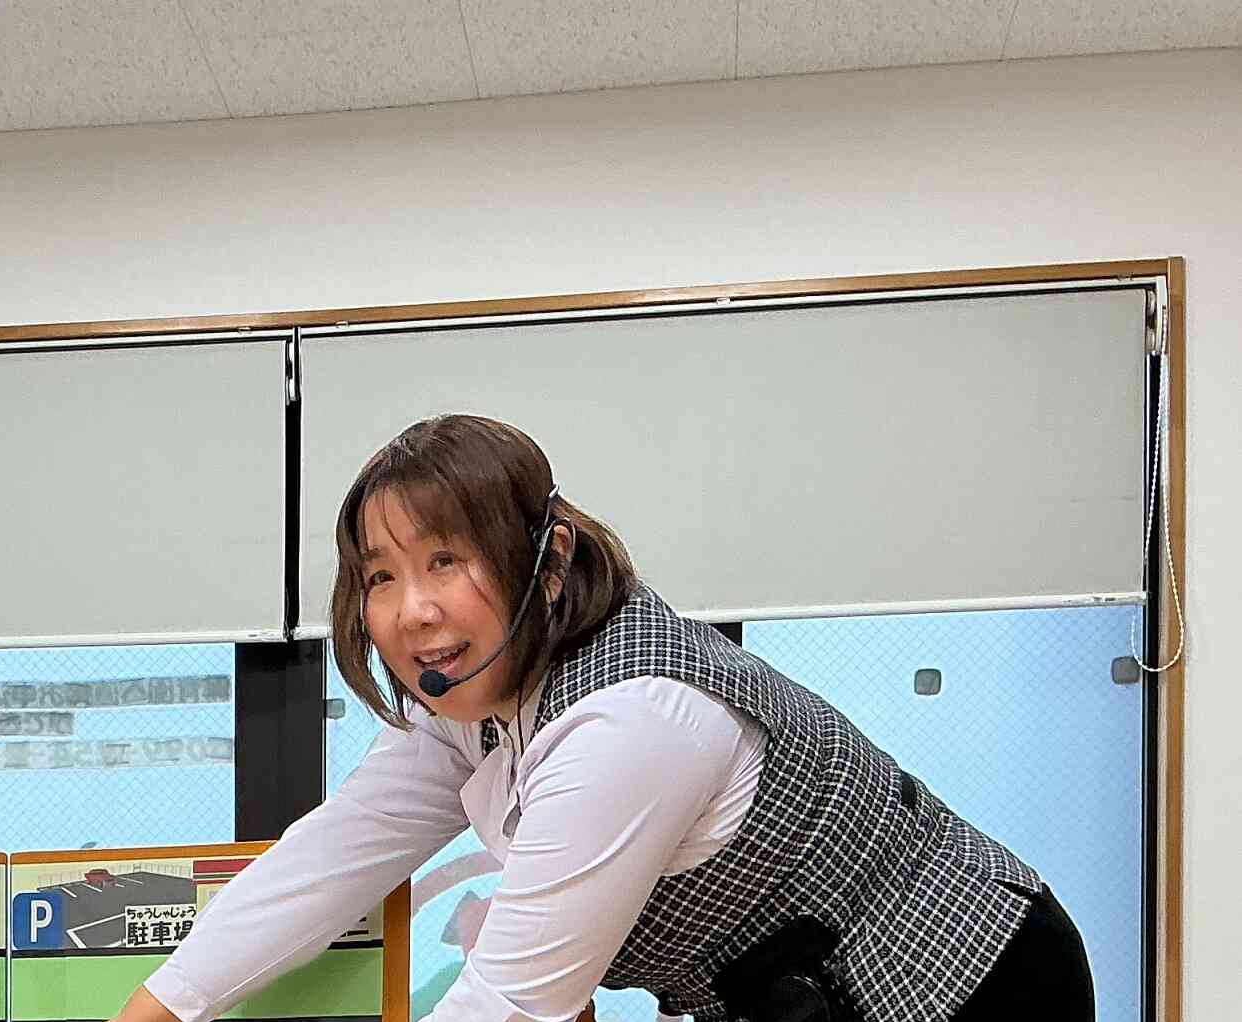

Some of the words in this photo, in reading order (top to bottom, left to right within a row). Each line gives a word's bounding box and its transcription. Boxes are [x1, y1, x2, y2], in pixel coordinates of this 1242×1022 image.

[30, 899, 53, 943] P
[126, 906, 197, 920] ちゅうしゃじょう
[127, 920, 194, 946] 駐車場
